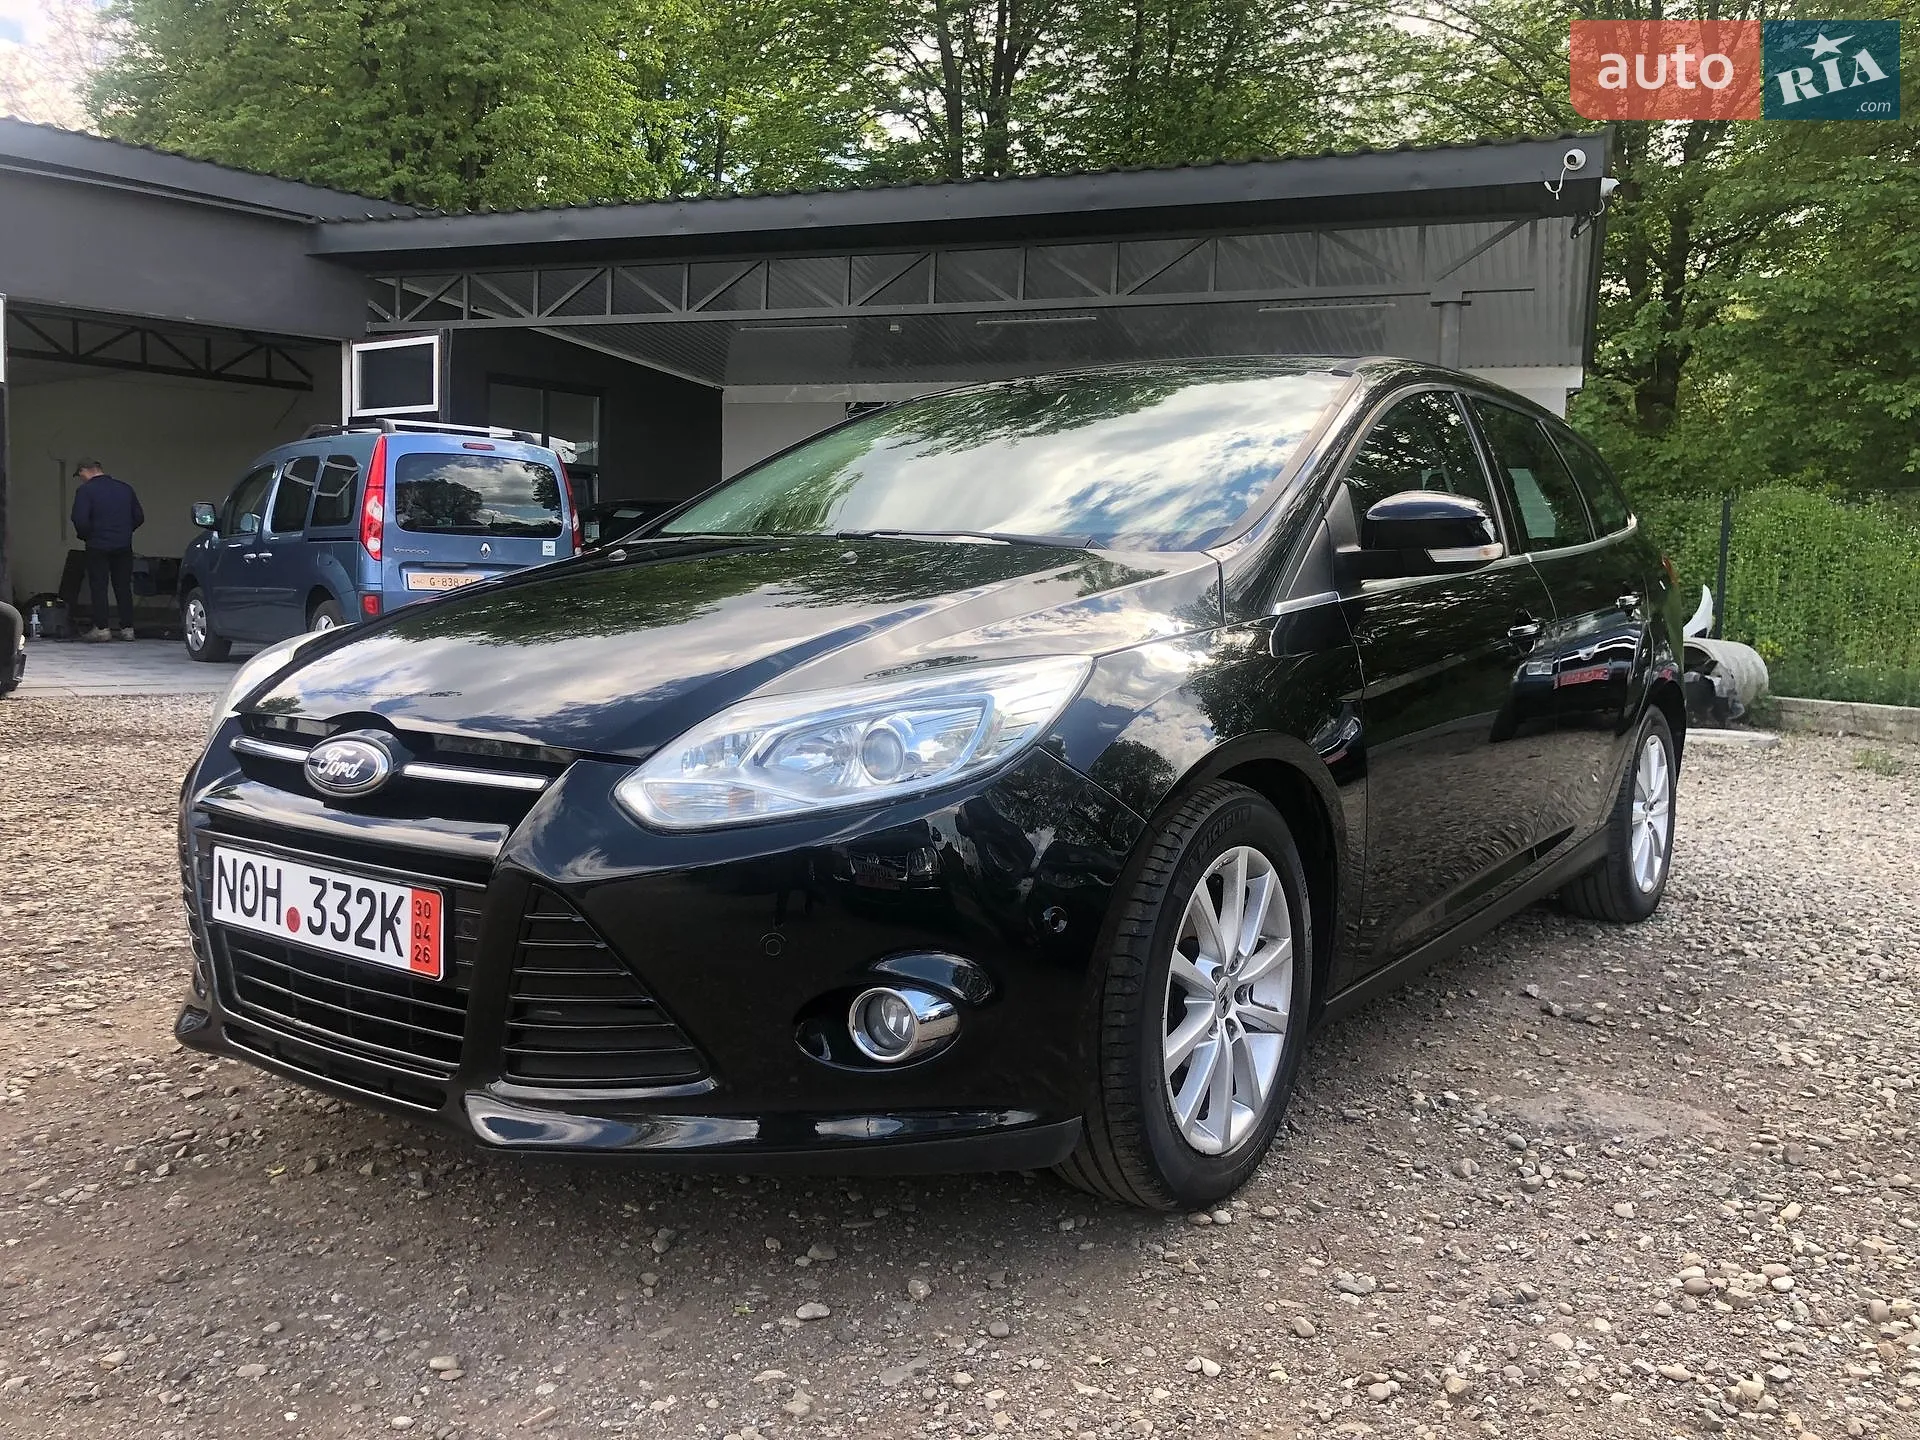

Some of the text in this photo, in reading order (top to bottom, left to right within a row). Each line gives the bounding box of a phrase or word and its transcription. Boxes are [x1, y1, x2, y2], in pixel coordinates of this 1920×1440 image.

[317, 746, 365, 779] Ford
[217, 855, 405, 957] NOH 332K
[415, 899, 432, 919] 30
[414, 923, 431, 942] 04
[414, 945, 431, 964] 26
